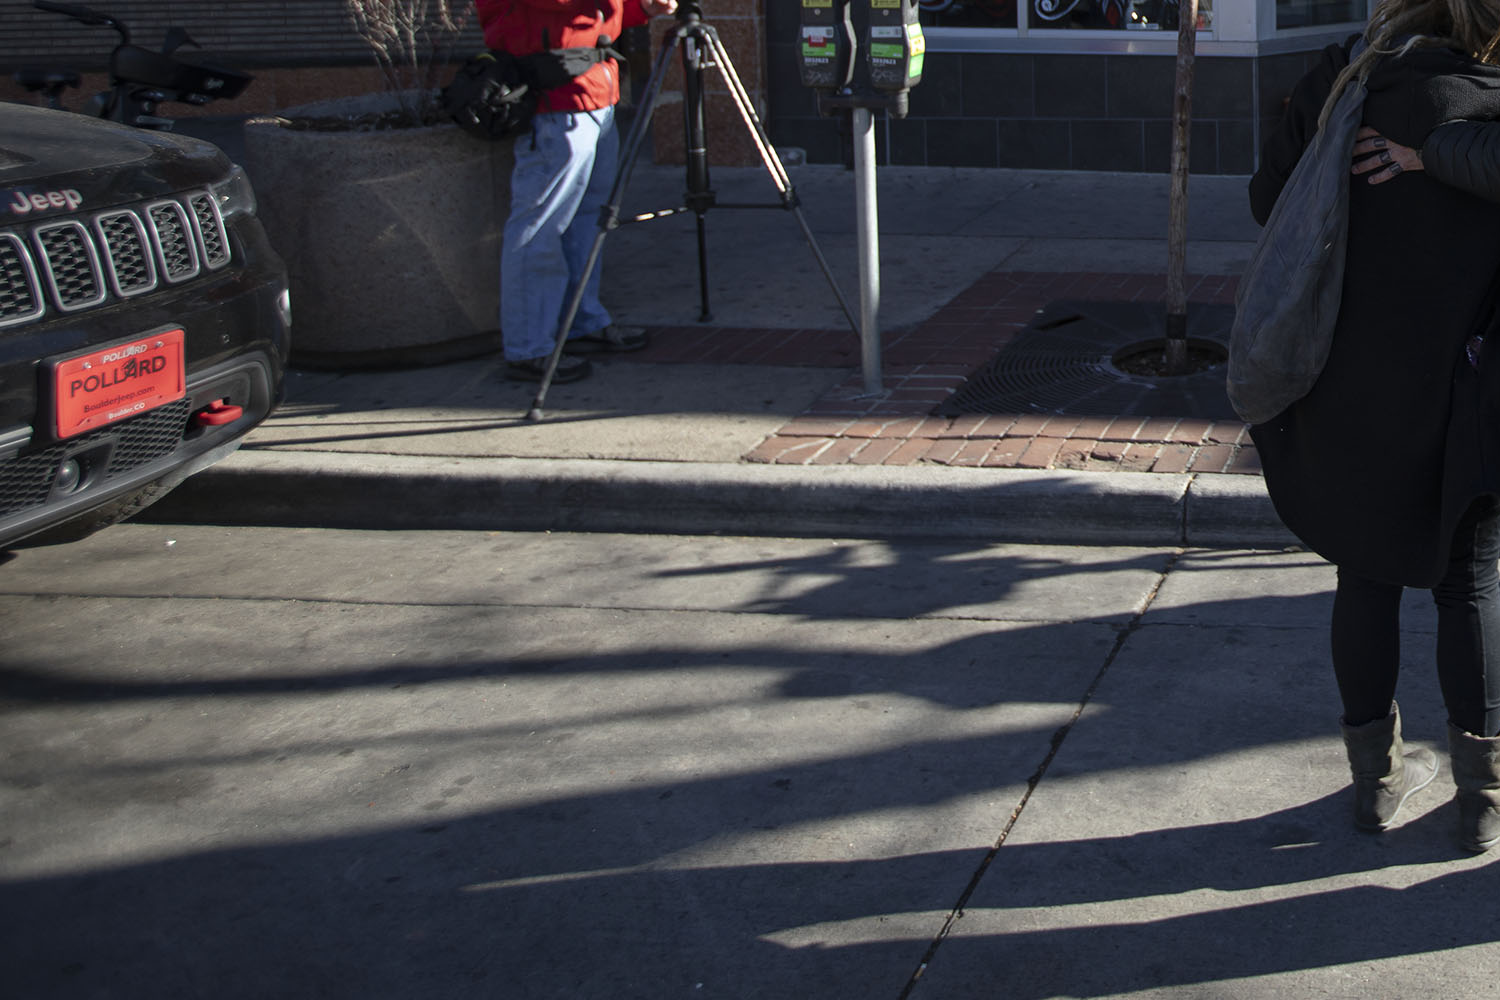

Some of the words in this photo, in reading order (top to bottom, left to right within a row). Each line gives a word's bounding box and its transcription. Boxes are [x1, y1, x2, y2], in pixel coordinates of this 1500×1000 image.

[9, 188, 84, 214] Jeep
[102, 344, 148, 363] POLLARD
[70, 355, 167, 397] POLLARD
